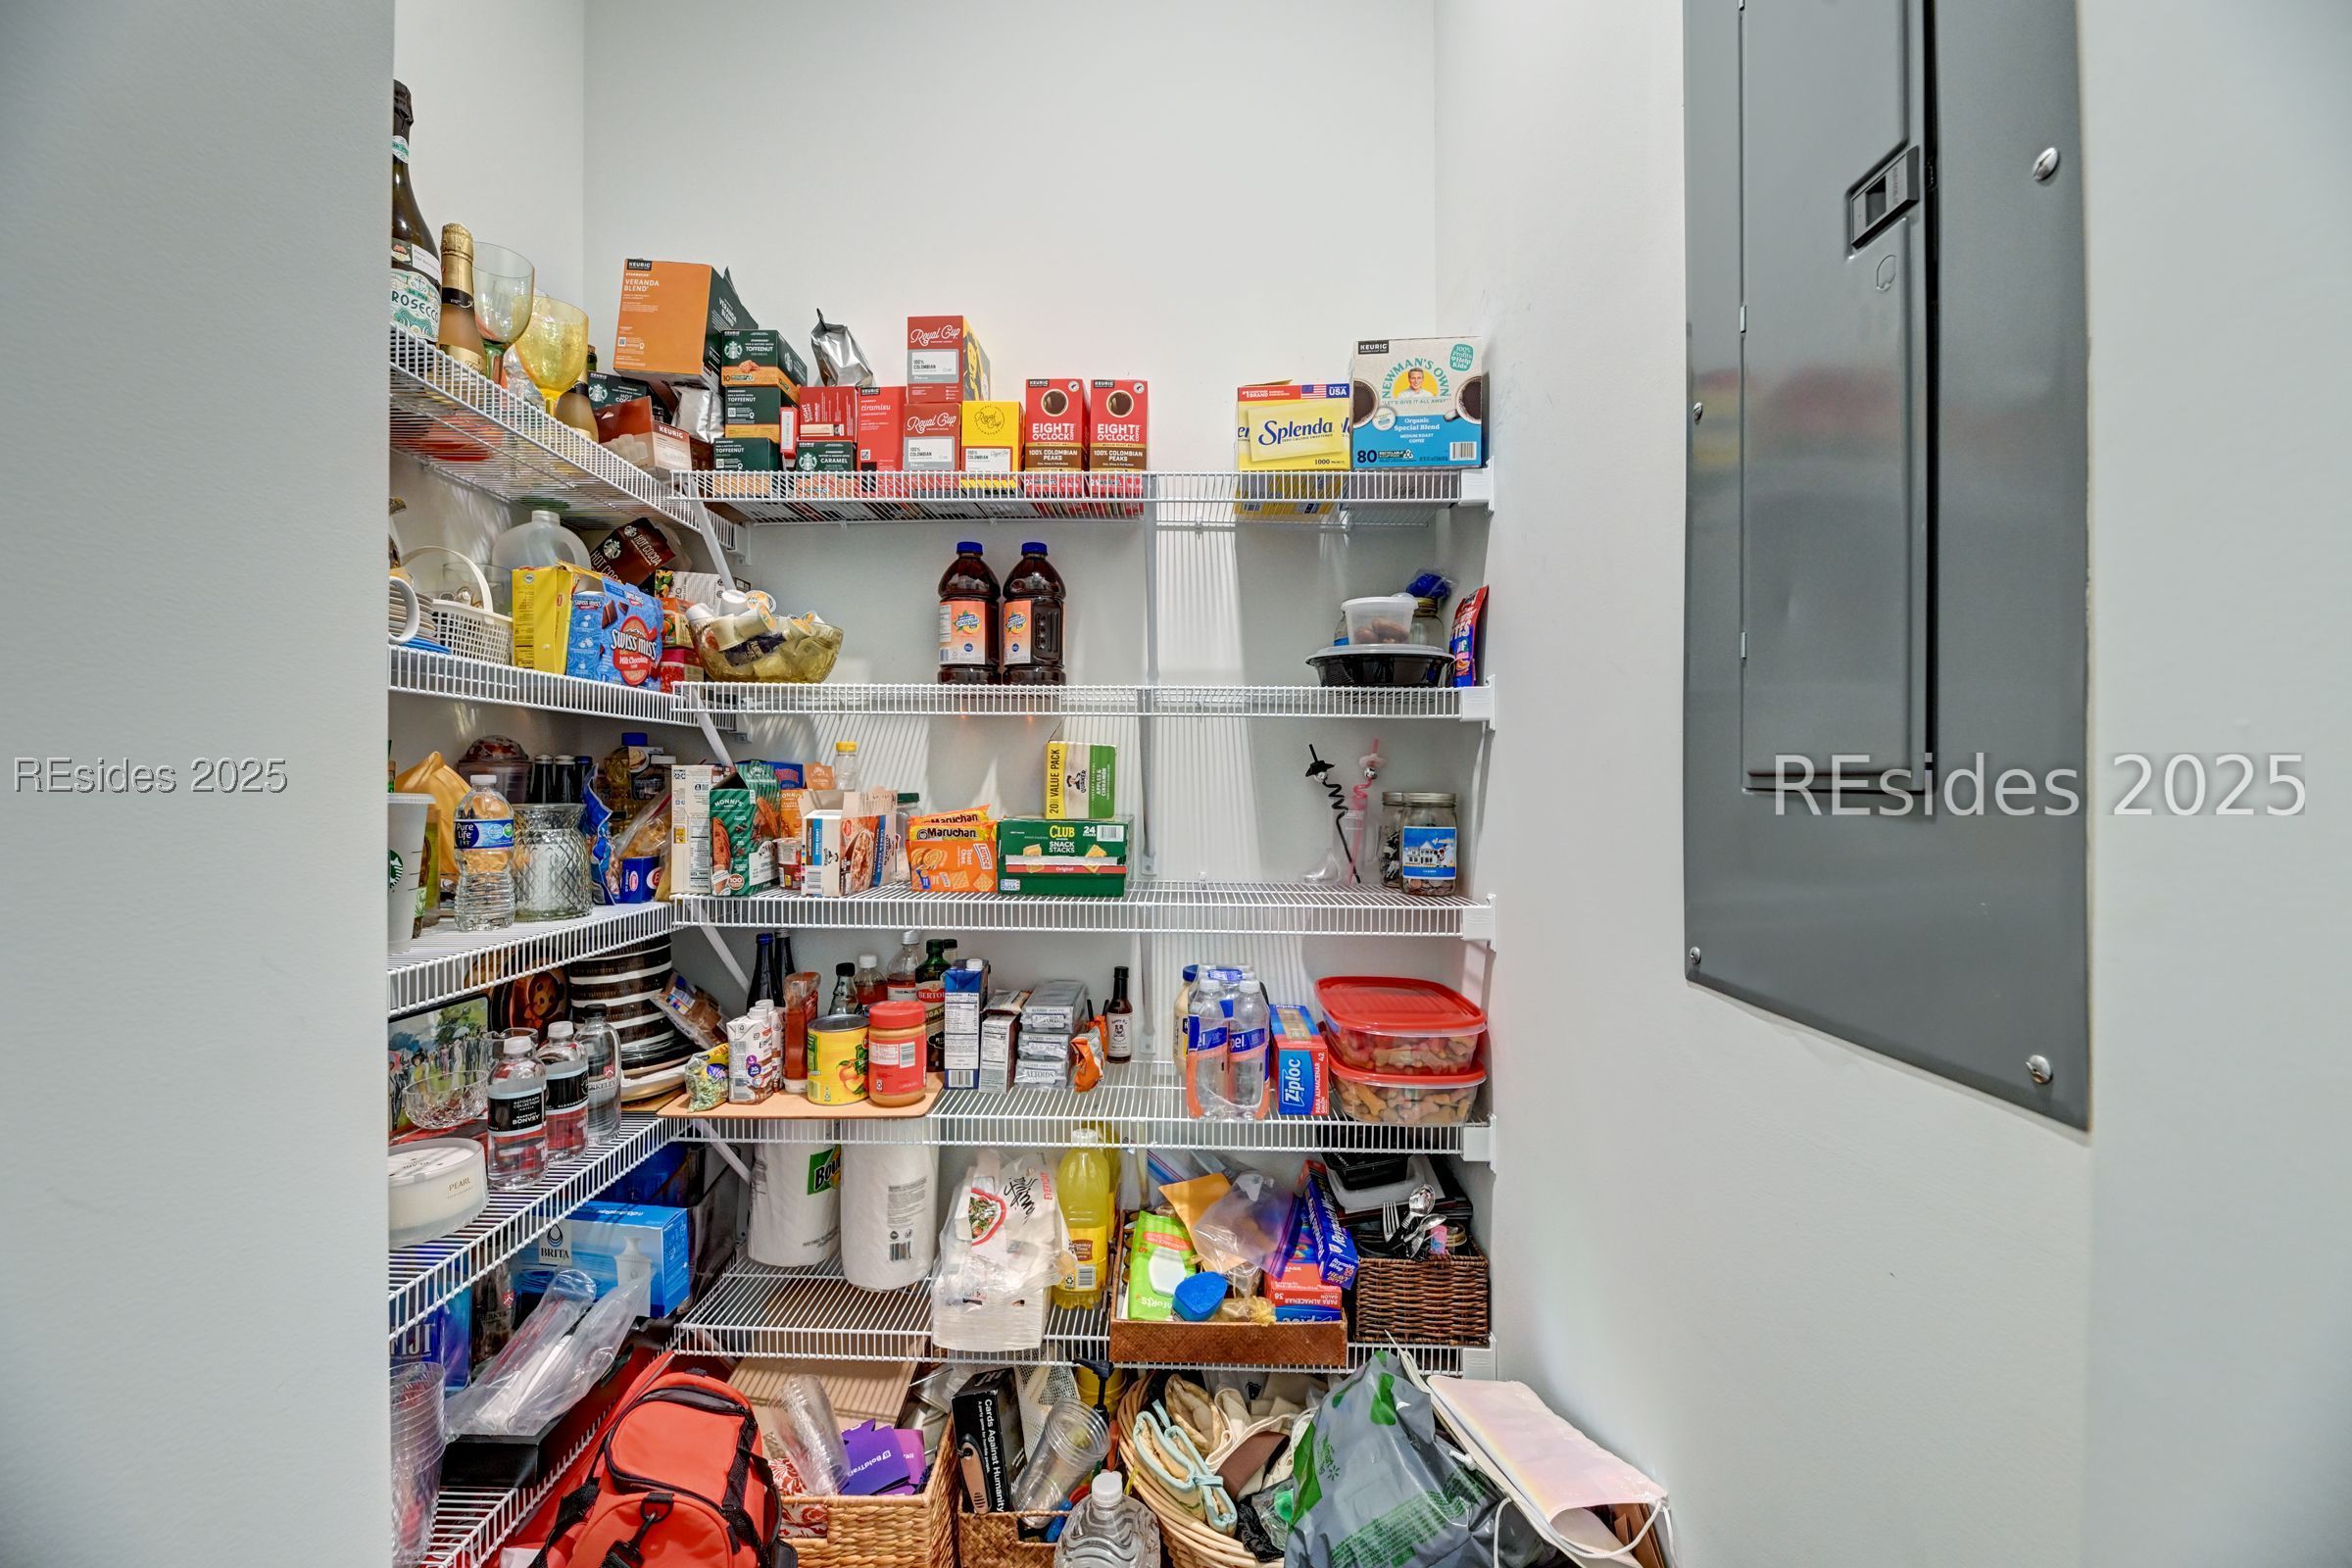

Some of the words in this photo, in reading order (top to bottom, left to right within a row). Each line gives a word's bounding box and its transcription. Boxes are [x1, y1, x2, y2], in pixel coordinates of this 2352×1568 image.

[910, 327, 941, 347] Royal
[941, 324, 960, 339] Cup
[1382, 357, 1434, 399] NEWMAN'S
[1434, 368, 1449, 397] OWN
[861, 403, 891, 412] tiramisu
[907, 416, 936, 434] Royal
[937, 412, 957, 427] Cup
[1032, 423, 1070, 434] EIGHT
[1097, 423, 1135, 434] EIGHT
[659, 425, 683, 439] KEURIG
[1258, 416, 1333, 446] Splenda
[1357, 449, 1377, 463] 80
[634, 534, 648, 548] HOT
[643, 545, 662, 566] COCOA
[590, 550, 608, 569] HOT
[610, 628, 638, 652] SWISS
[1050, 749, 1060, 770] PACK
[1050, 772, 1059, 797] VALUE
[713, 798, 745, 808] NONNI'S
[458, 830, 472, 841] Life
[927, 828, 976, 838] Maruchan
[1050, 825, 1075, 838] CLUB
[1083, 825, 1096, 834] 24
[1318, 1053, 1325, 1061] 42
[1284, 1058, 1305, 1102] Ziploc
[512, 1114, 540, 1125] BONVOY
[448, 1177, 471, 1191] PEARL
[541, 1248, 569, 1259] BRITA
[984, 1398, 995, 1428] Cards
[988, 1429, 1000, 1466] Against
[993, 1466, 1005, 1512] Humanity
